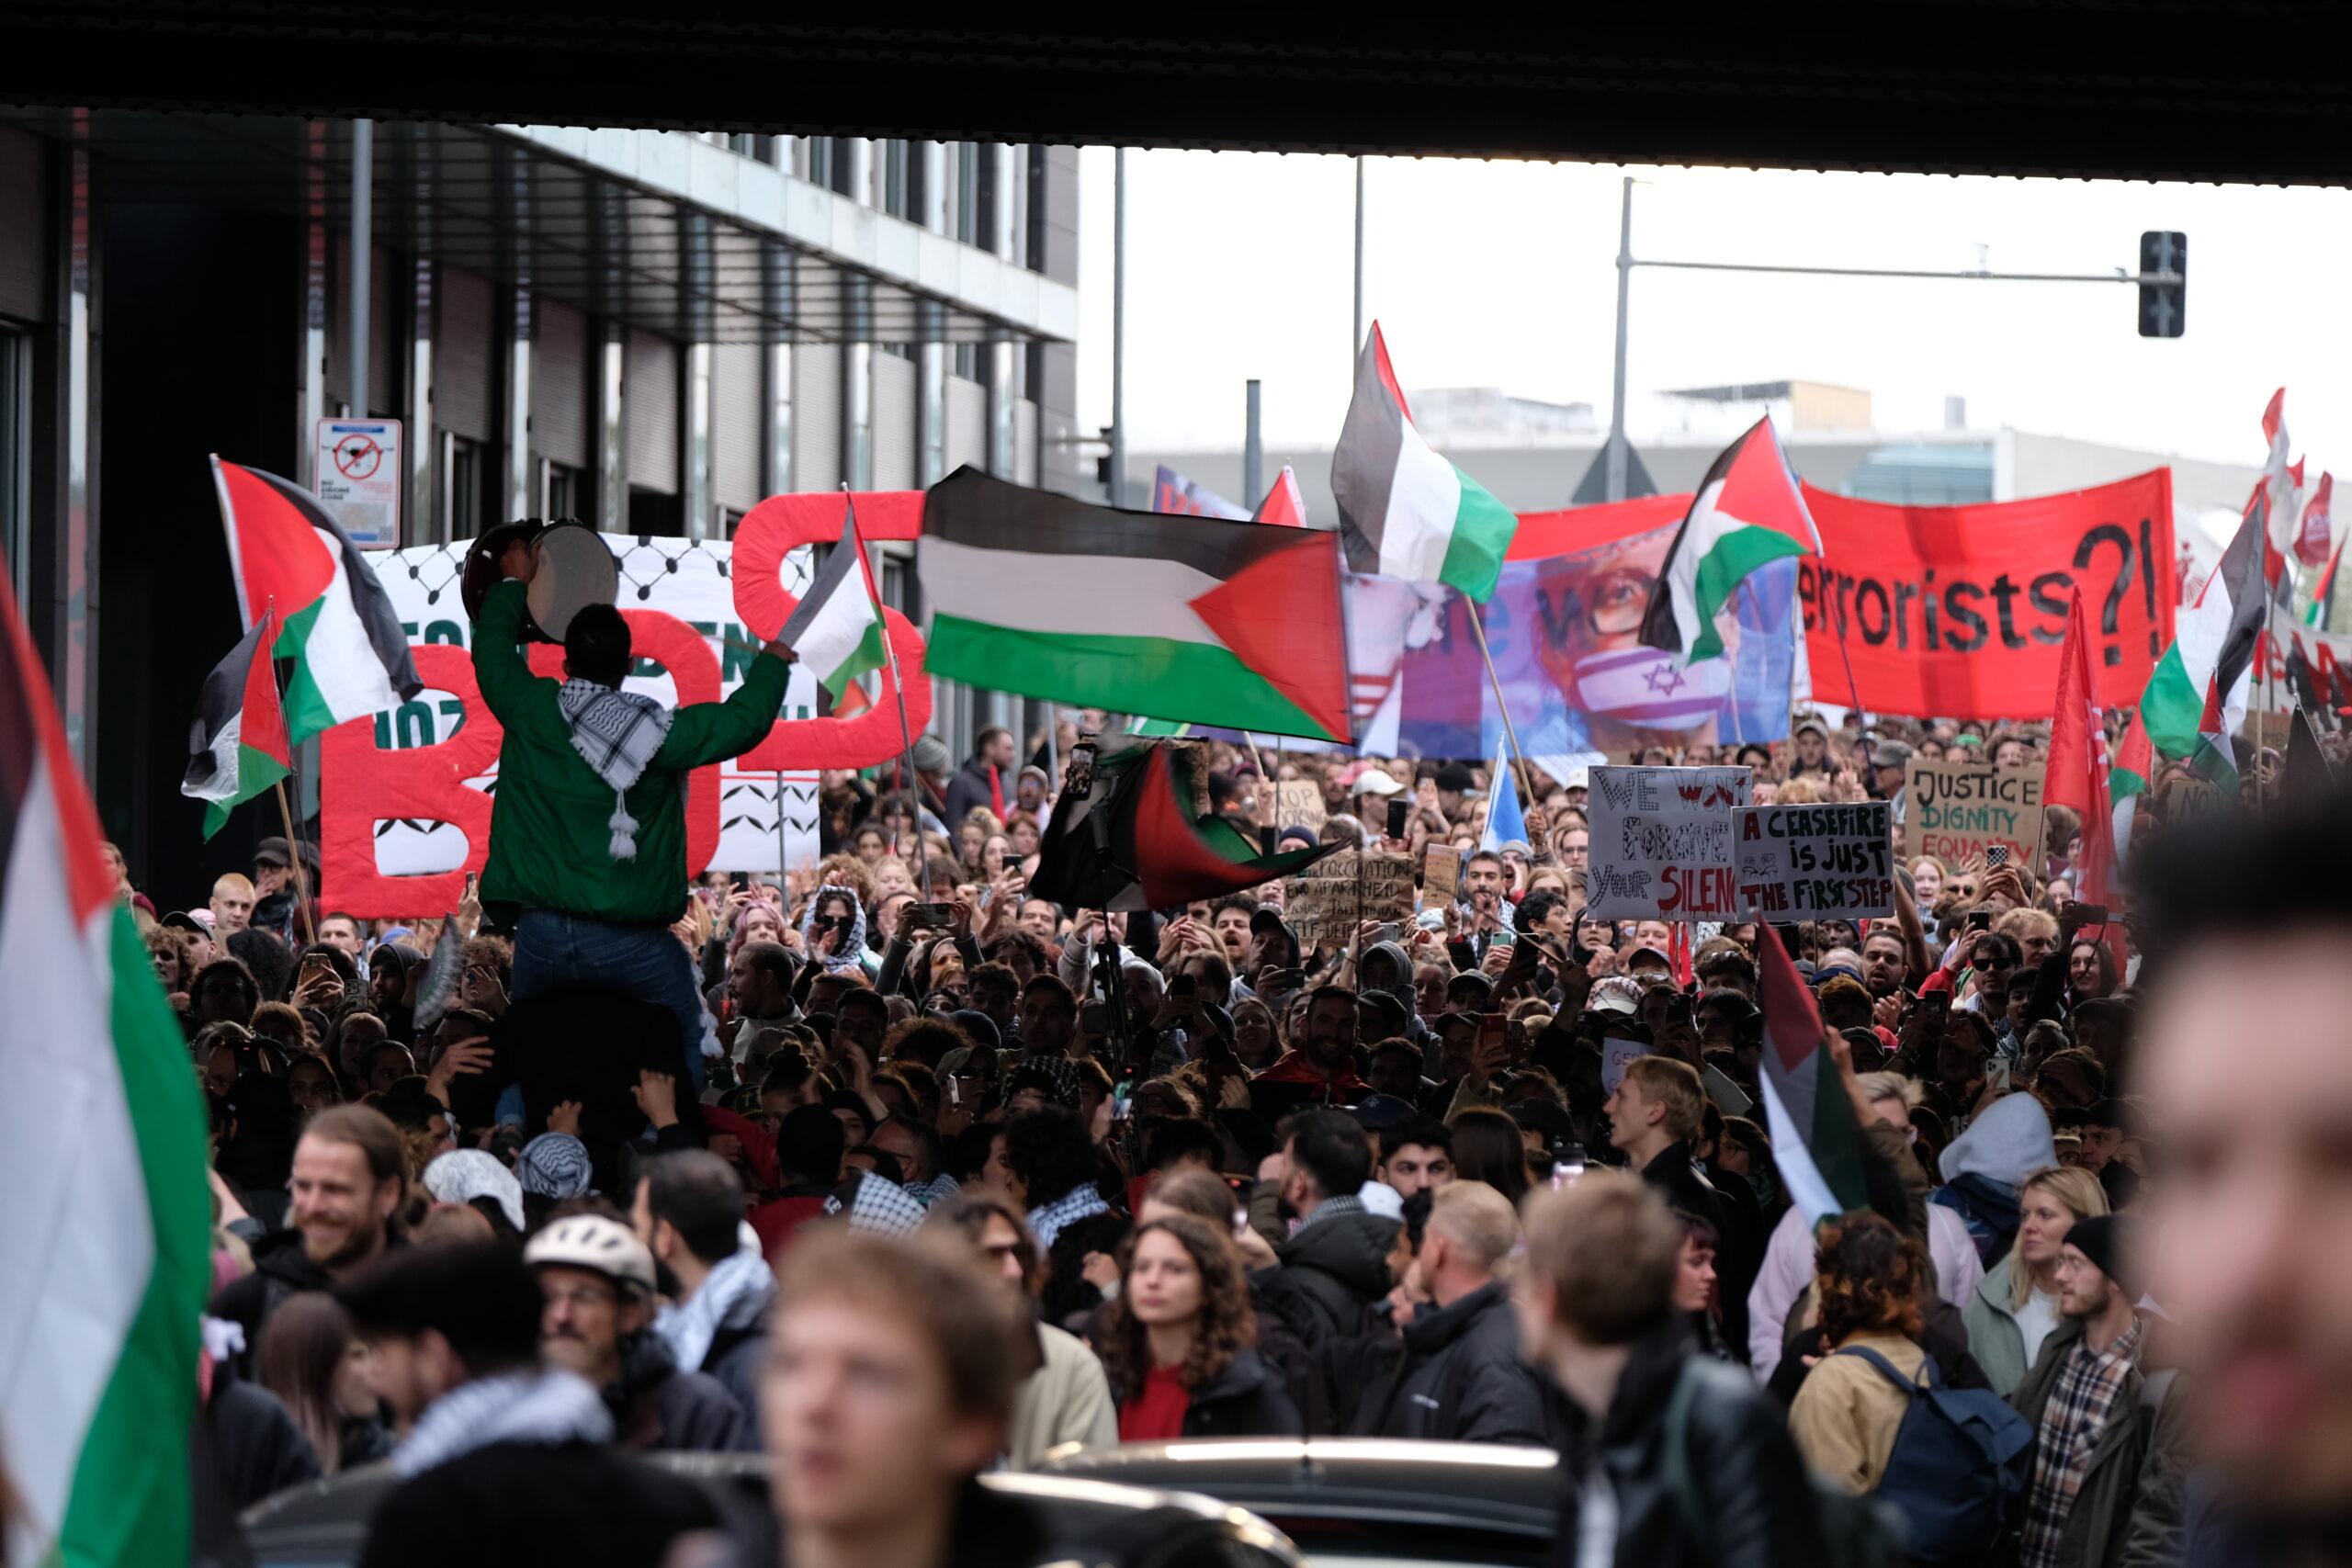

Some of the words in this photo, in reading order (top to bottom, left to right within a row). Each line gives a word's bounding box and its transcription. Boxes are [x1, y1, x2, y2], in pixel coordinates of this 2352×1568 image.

[1594, 770, 1659, 811] WE
[1743, 812, 1761, 840] A
[1329, 860, 1411, 879] OCCUATION
[1657, 866, 1737, 916] SILEN
[1740, 882, 1790, 911] THE
[1846, 877, 1894, 908] STEP
[1332, 899, 1402, 918] PALETINIAN
